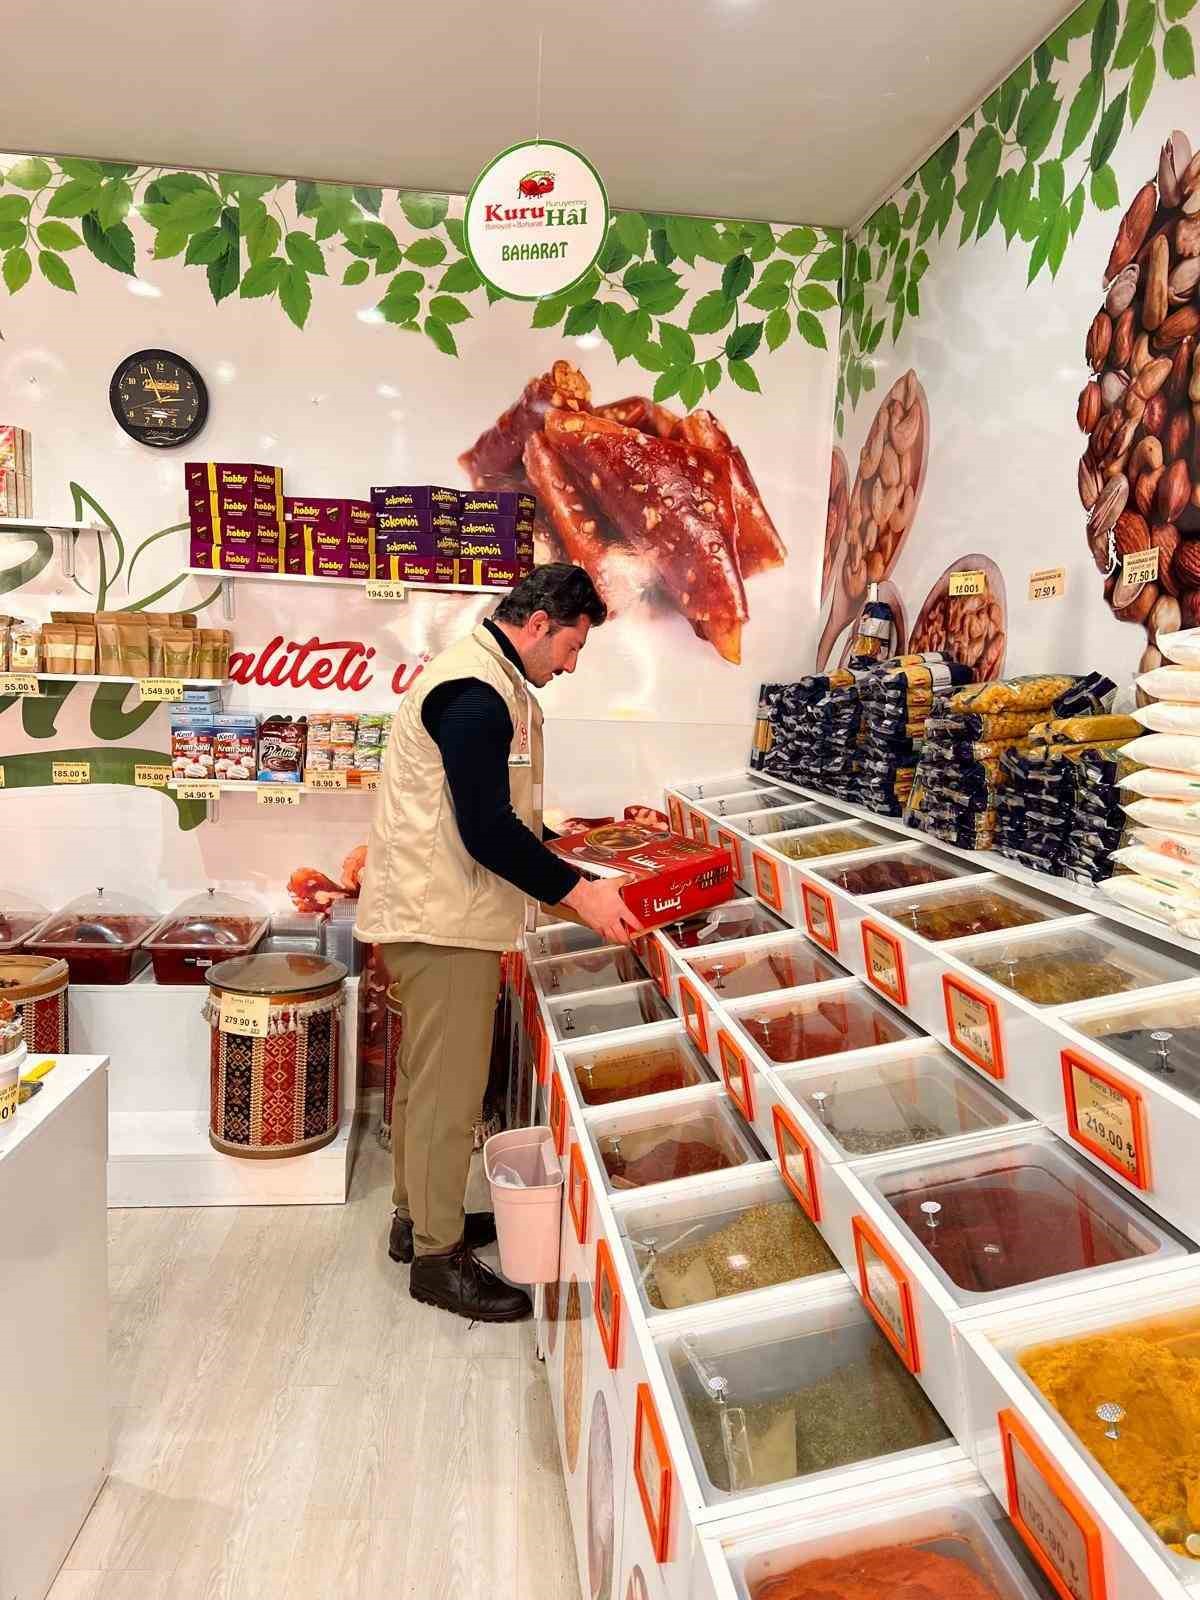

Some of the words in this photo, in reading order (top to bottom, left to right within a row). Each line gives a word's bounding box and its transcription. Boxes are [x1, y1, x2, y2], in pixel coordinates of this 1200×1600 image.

[484, 203, 545, 221] Kuru
[545, 207, 588, 226] Hâl
[501, 241, 568, 261] BAHARAT
[222, 474, 248, 484] hobby
[223, 501, 248, 512] hobby
[293, 505, 320, 516] hobby
[226, 528, 251, 539] hobby
[225, 554, 250, 565] hobby
[319, 561, 343, 570] hobby
[488, 571, 514, 580] hobby
[1128, 569, 1150, 584] 27.50
[367, 590, 394, 598] 194.90
[228, 635, 377, 692] aliteli
[4, 683, 29, 691] 55.00
[54, 770, 80, 778] 185.00
[138, 773, 164, 781] 185.00
[184, 791, 207, 799] 54.90
[263, 796, 286, 804] 39.90
[224, 1015, 250, 1027] 279.90
